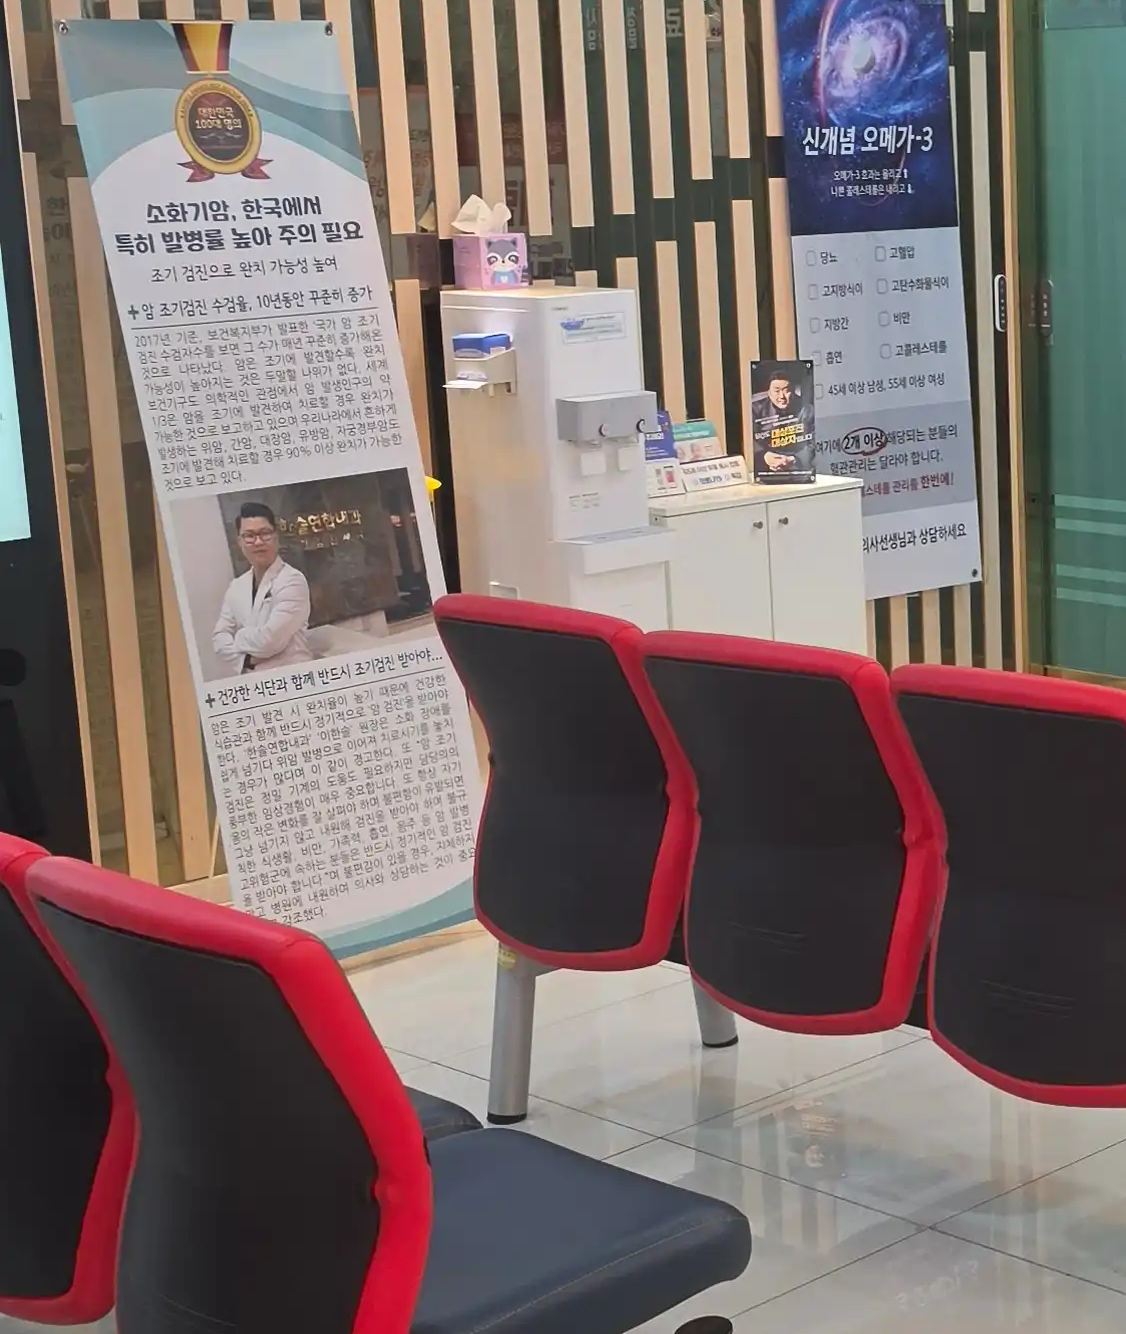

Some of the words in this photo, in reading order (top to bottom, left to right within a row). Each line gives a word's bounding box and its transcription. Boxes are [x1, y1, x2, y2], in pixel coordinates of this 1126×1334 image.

[802, 125, 856, 156] 신개념
[861, 125, 933, 154] 오메가-3
[146, 200, 236, 224] 소화기암,
[241, 196, 322, 220] 한국에서
[115, 233, 155, 256] 특히
[161, 228, 224, 253] 발병률
[232, 226, 272, 249] 높아
[279, 224, 316, 246] 주의
[323, 221, 363, 242] 필요
[151, 267, 177, 283] 조기
[182, 264, 236, 282] 검진으로
[240, 260, 265, 278] 완치
[270, 257, 308, 275] 가능성
[312, 255, 337, 272] 높여
[820, 251, 837, 264] 당뇨
[142, 304, 153, 319] 암
[160, 300, 207, 317] 조기검진
[257, 291, 304, 310] 10년동안
[309, 288, 343, 305] 꾸준히
[348, 286, 372, 301] 증가
[824, 317, 849, 331] 지방간
[844, 437, 860, 449] 2개
[864, 434, 883, 447] 이상
[919, 524, 966, 545] 상담하세요
[218, 684, 250, 705] 건강한
[254, 678, 288, 698] 식단과
[291, 673, 316, 691] 함께
[318, 667, 351, 686] 반드시
[355, 657, 394, 676] 조기검진
